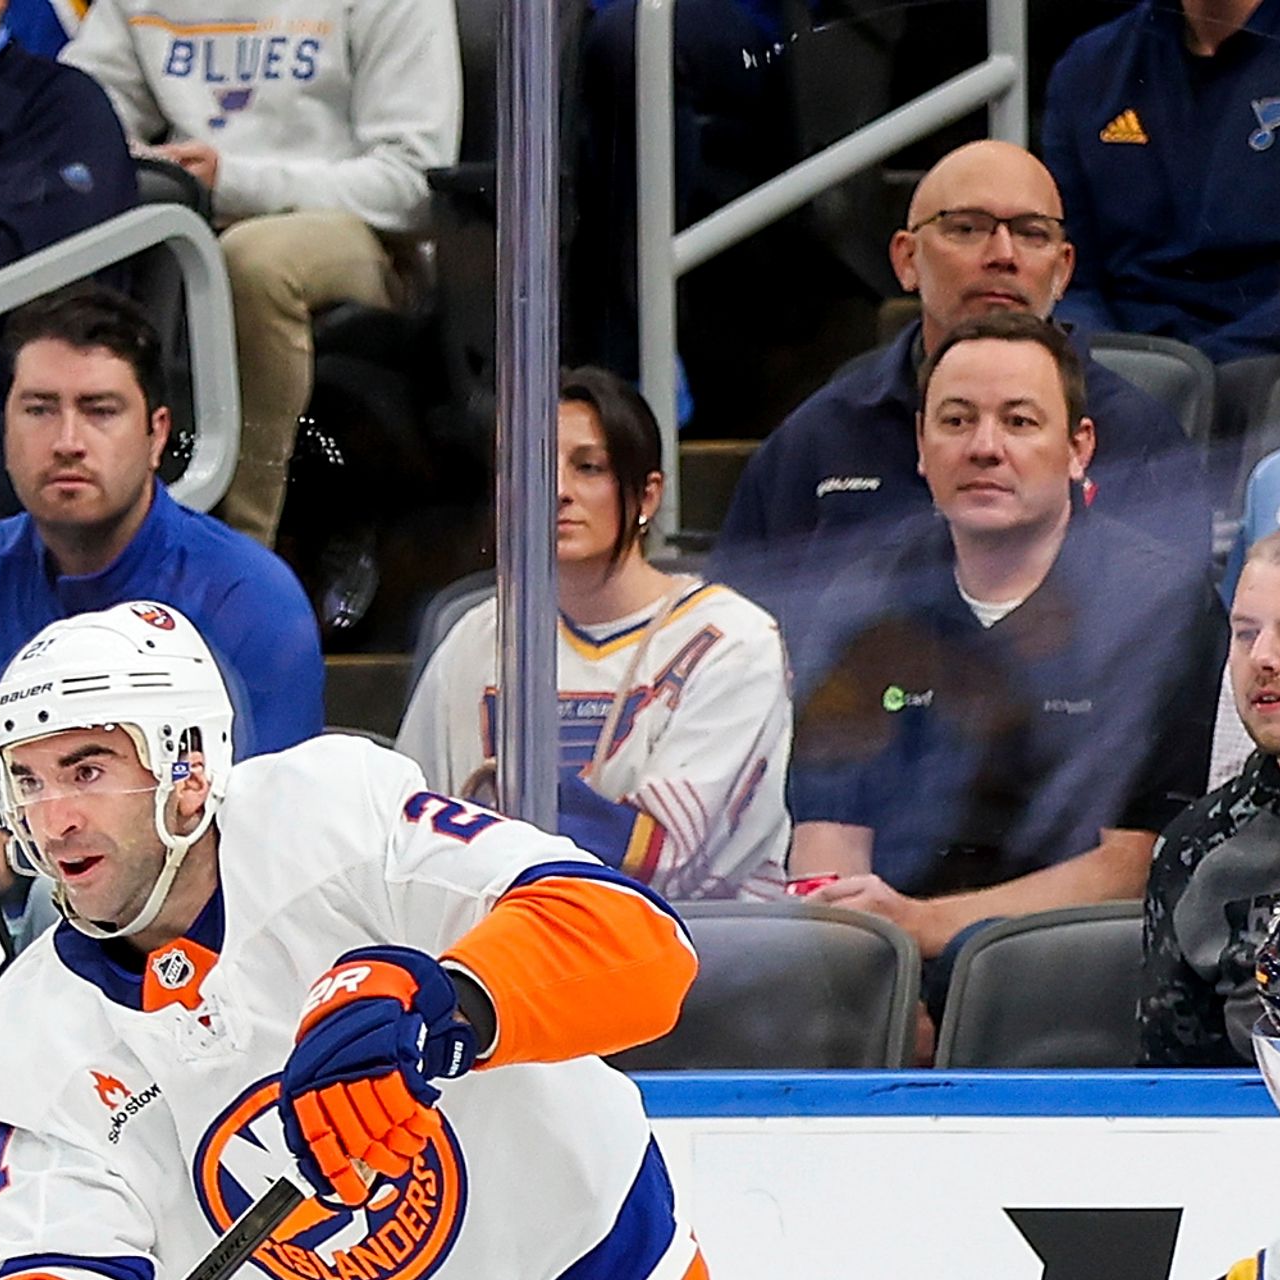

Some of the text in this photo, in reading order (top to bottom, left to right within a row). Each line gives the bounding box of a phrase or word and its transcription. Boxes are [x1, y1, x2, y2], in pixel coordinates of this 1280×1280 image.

[164, 37, 320, 82] BLUES
[0, 682, 54, 706] BAUER
[107, 1110, 128, 1145] solo
